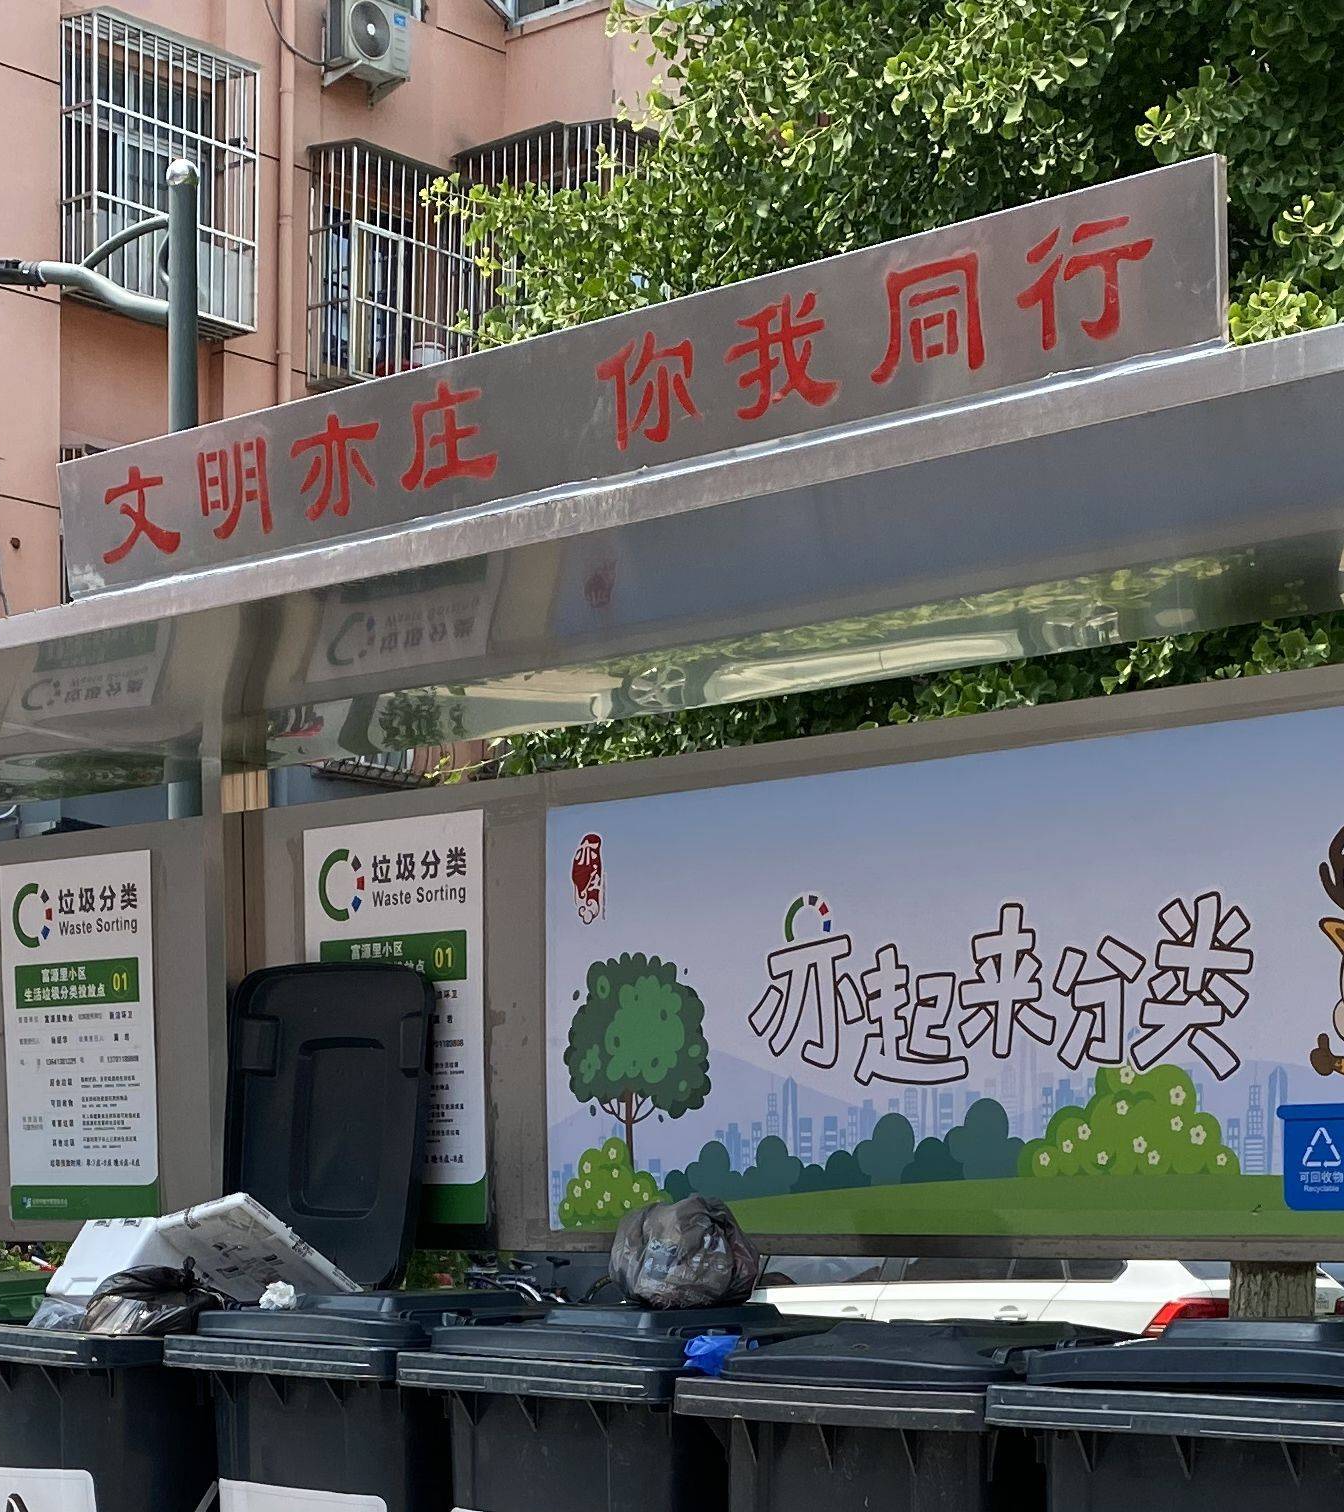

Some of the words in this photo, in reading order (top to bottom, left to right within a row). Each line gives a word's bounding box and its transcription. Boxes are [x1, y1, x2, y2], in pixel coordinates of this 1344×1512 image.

[102, 384, 498, 564] 文明亦庄
[597, 215, 1154, 451] 你我同行
[371, 845, 468, 885] 垃圾分类
[58, 882, 138, 915] 垃圾分类
[371, 887, 411, 909] Waste
[416, 883, 467, 906] Sorting
[58, 920, 93, 936] Waste
[96, 917, 138, 934] Sorting
[350, 941, 403, 961] 富源里小区
[434, 947, 453, 969] 01
[41, 966, 87, 983] 富源里小区
[112, 972, 128, 992] 01
[748, 890, 1254, 1086] 亦起来分类
[1299, 1171, 1344, 1184] 可回收物
